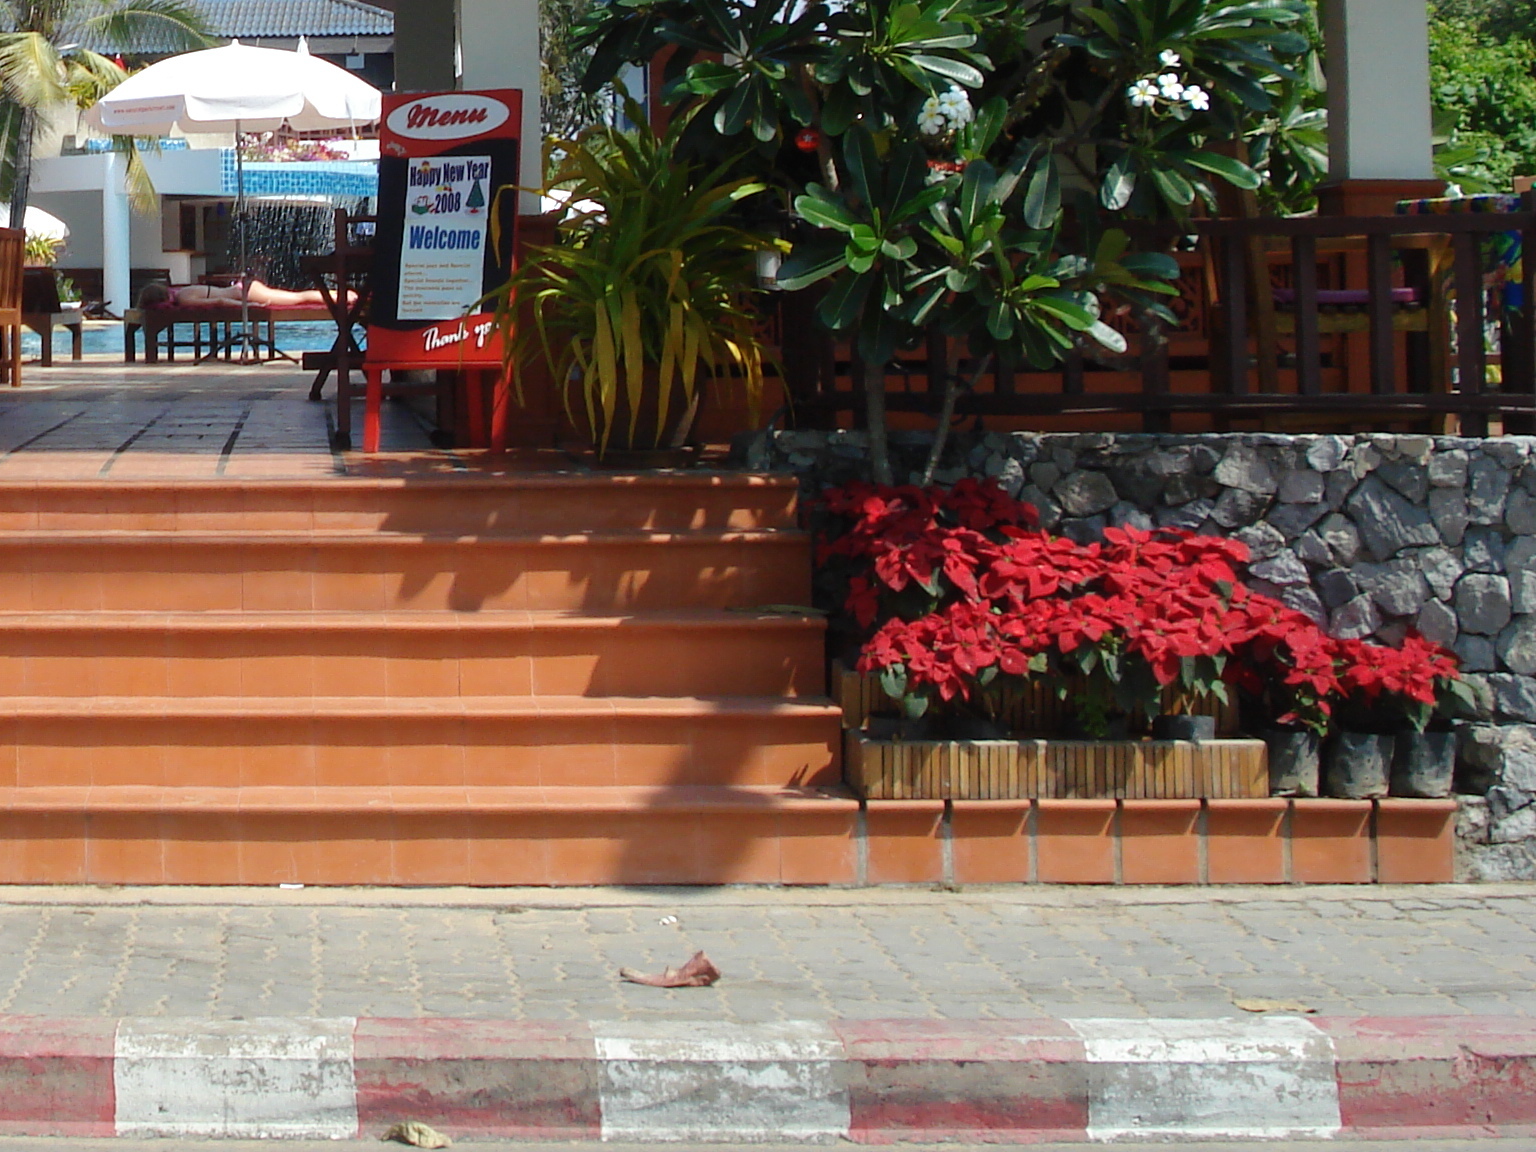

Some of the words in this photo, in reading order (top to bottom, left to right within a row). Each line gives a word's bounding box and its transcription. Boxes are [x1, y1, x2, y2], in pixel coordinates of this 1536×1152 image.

[406, 103, 489, 130] Menu
[410, 165, 442, 188] Happy
[443, 162, 465, 183] New
[467, 160, 490, 181] Year
[435, 191, 461, 214] 2008
[409, 225, 481, 250] Welcome
[474, 321, 500, 348] yo
